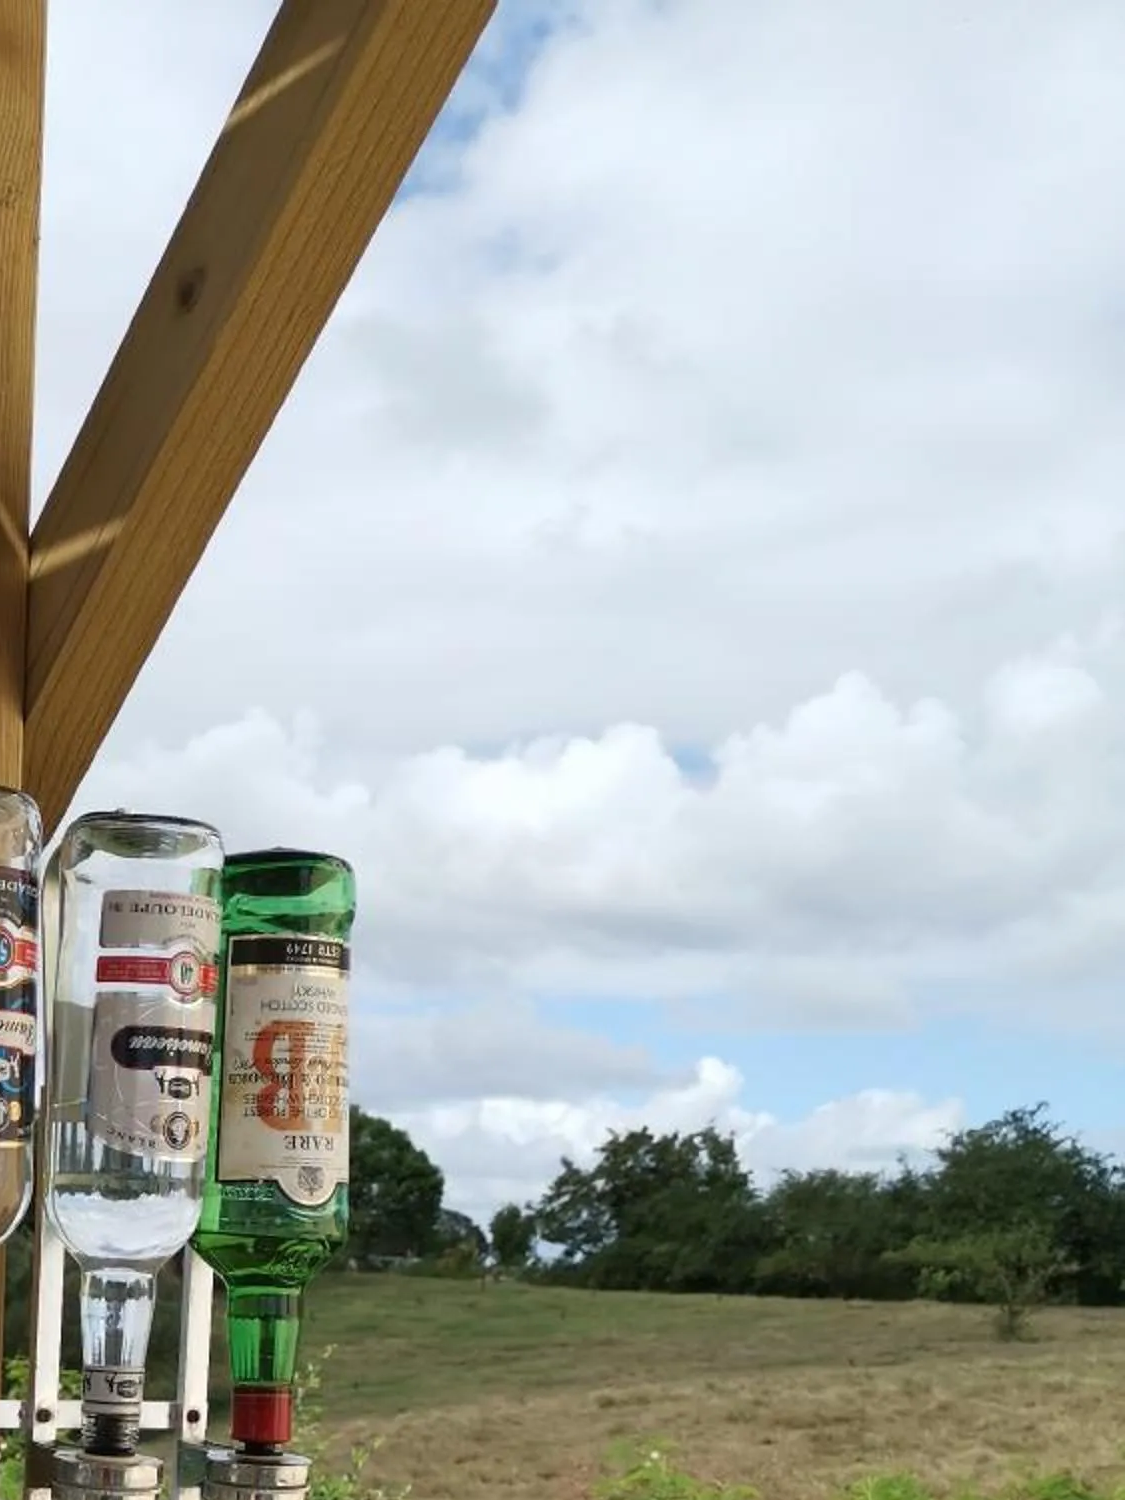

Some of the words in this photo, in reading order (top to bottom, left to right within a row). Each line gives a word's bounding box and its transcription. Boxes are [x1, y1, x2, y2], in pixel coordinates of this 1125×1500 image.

[285, 943, 313, 956] 1749
[106, 1127, 157, 1150] BLANC
[282, 1135, 334, 1152] RARE
